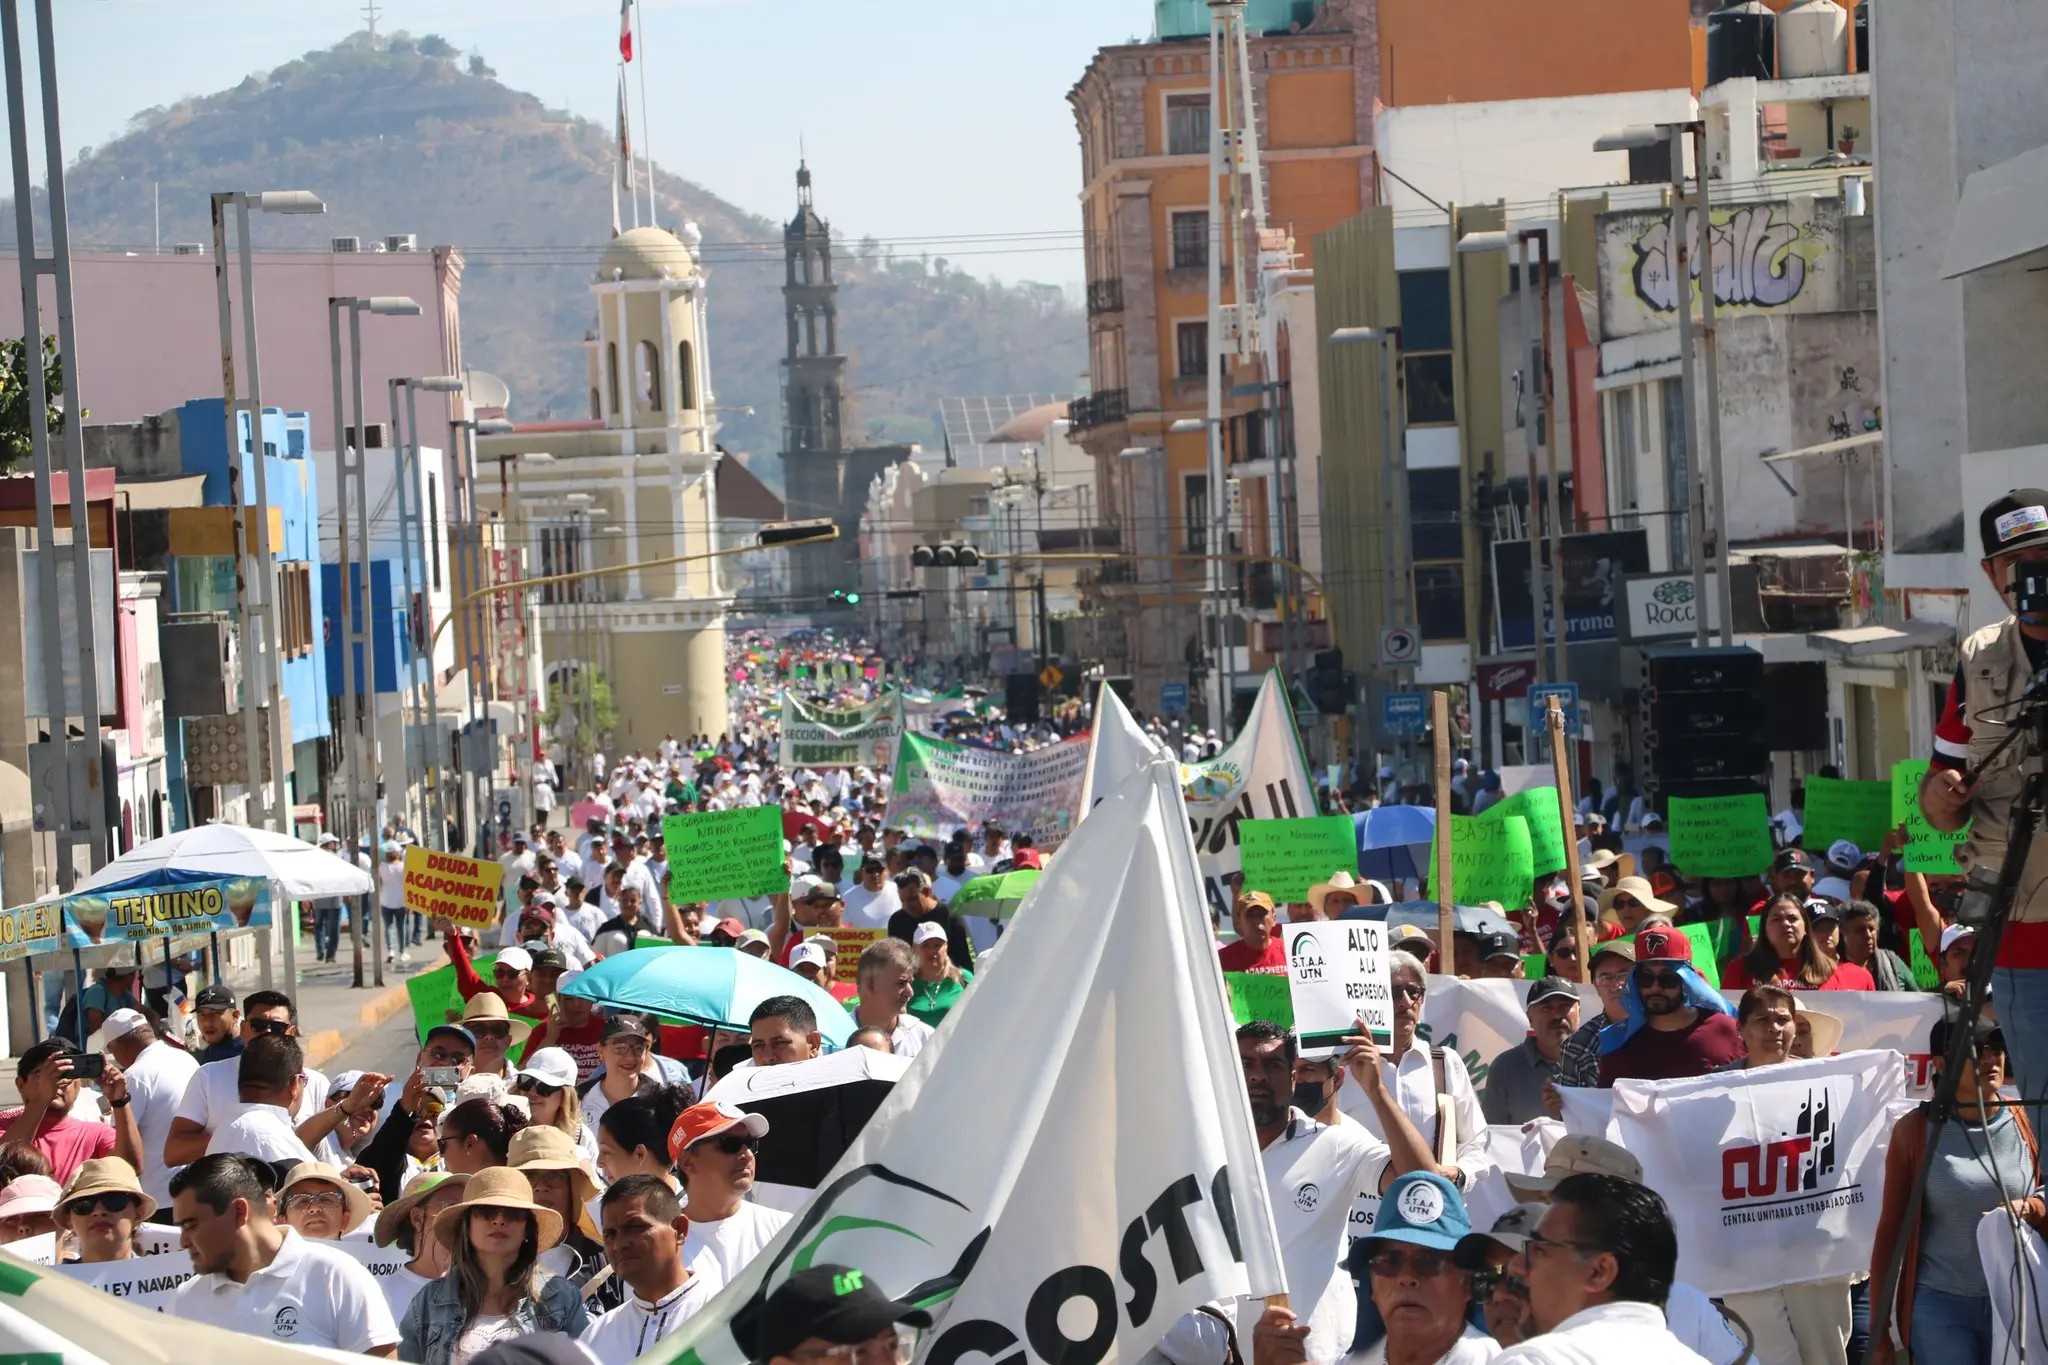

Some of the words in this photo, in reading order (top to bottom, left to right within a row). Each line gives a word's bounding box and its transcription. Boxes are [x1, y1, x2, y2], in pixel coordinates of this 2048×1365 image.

[785, 728, 825, 740] SECCIÓN
[1905, 813, 1922, 826] de
[1451, 818, 1510, 845] BASTA
[426, 853, 479, 878] DEUDA
[405, 870, 495, 903] ACAPONETA
[109, 887, 224, 928] TEJUINO
[1348, 928, 1379, 952] ALTO
[1291, 955, 1327, 968] S.T.A.A.
[1359, 957, 1366, 974] A
[1367, 957, 1377, 974] LA
[1300, 968, 1323, 980] UTN
[1345, 979, 1389, 1001] REPRESIÓN
[1356, 1009, 1386, 1027] SINDICAL
[1721, 1135, 1812, 1201] CUT
[1298, 1198, 1313, 1208] UTN
[1408, 1206, 1430, 1216] UTN
[1723, 1210, 1756, 1227] CENTRAL
[1757, 1206, 1794, 1222] UNITARIA
[1795, 1204, 1805, 1216] DE
[1806, 1191, 1865, 1214] TRABAJADORES
[1349, 1209, 1375, 1226] LOS
